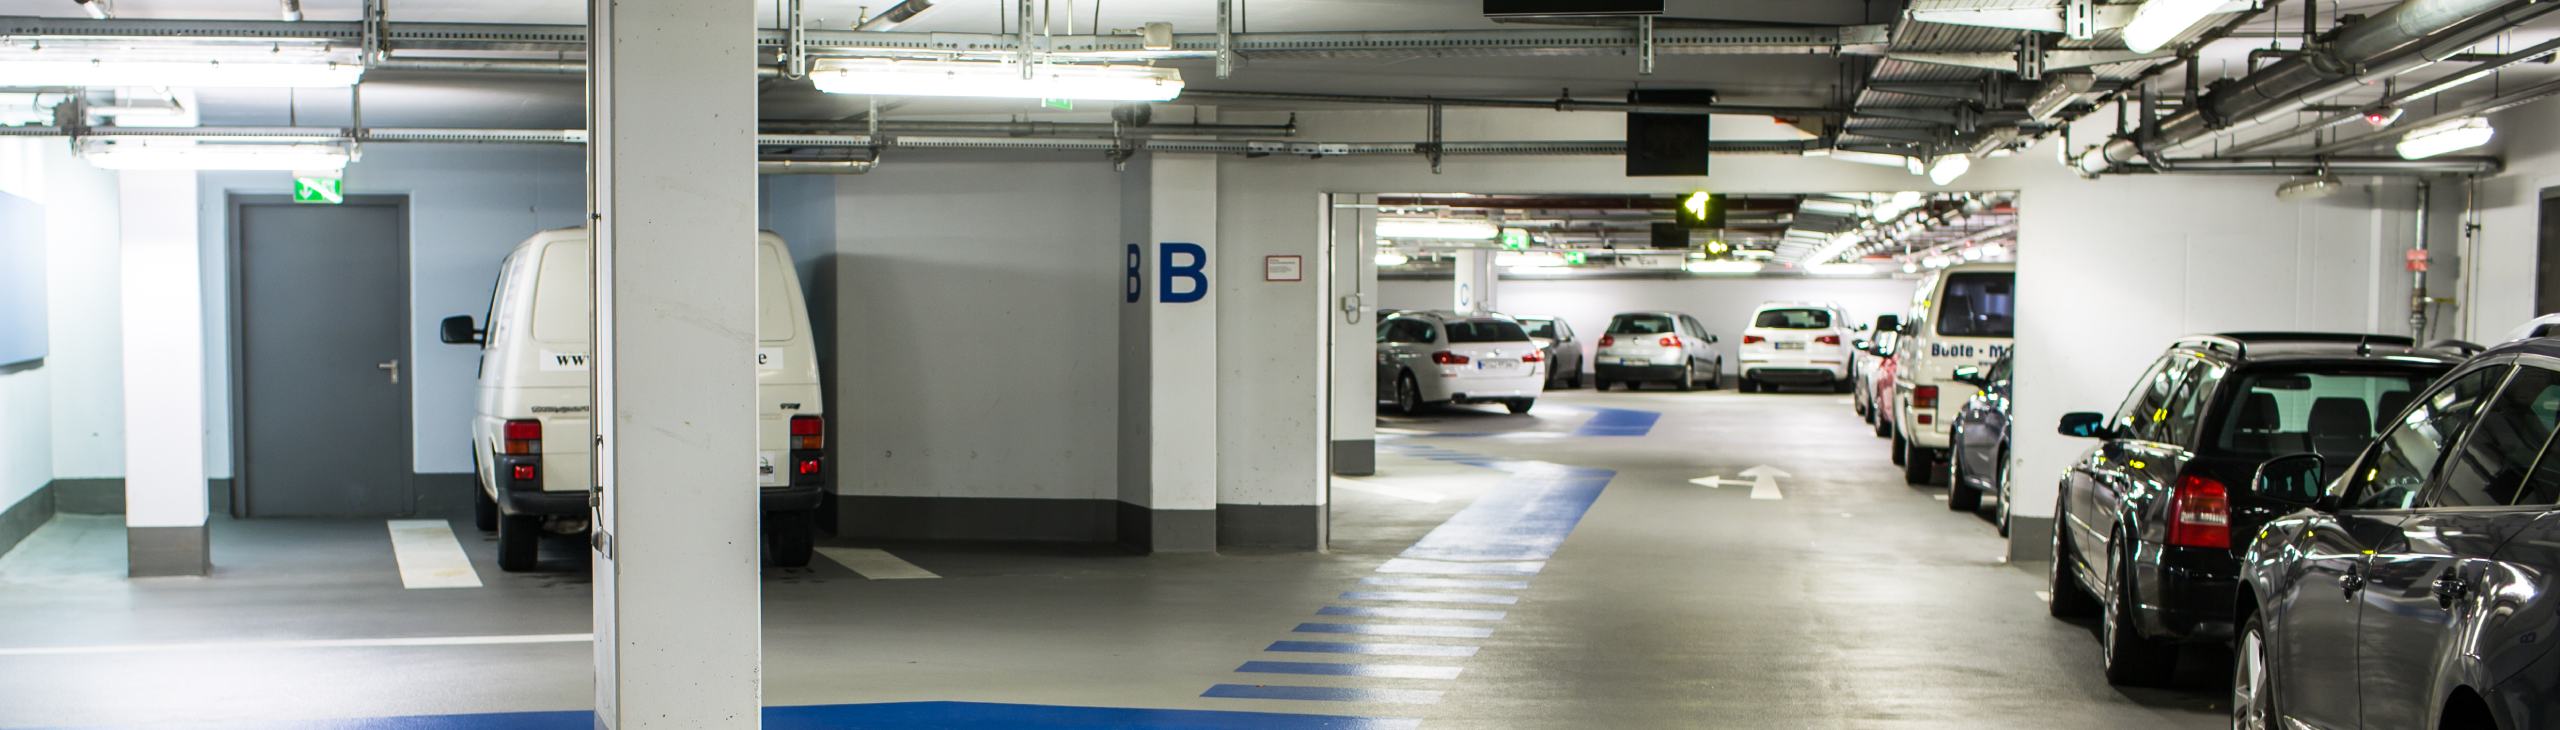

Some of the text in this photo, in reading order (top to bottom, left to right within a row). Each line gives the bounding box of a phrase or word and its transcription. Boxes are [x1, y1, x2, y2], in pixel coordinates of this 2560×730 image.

[1126, 243, 1141, 303] B
[1159, 242, 1209, 303] B
[556, 354, 590, 367] ww
